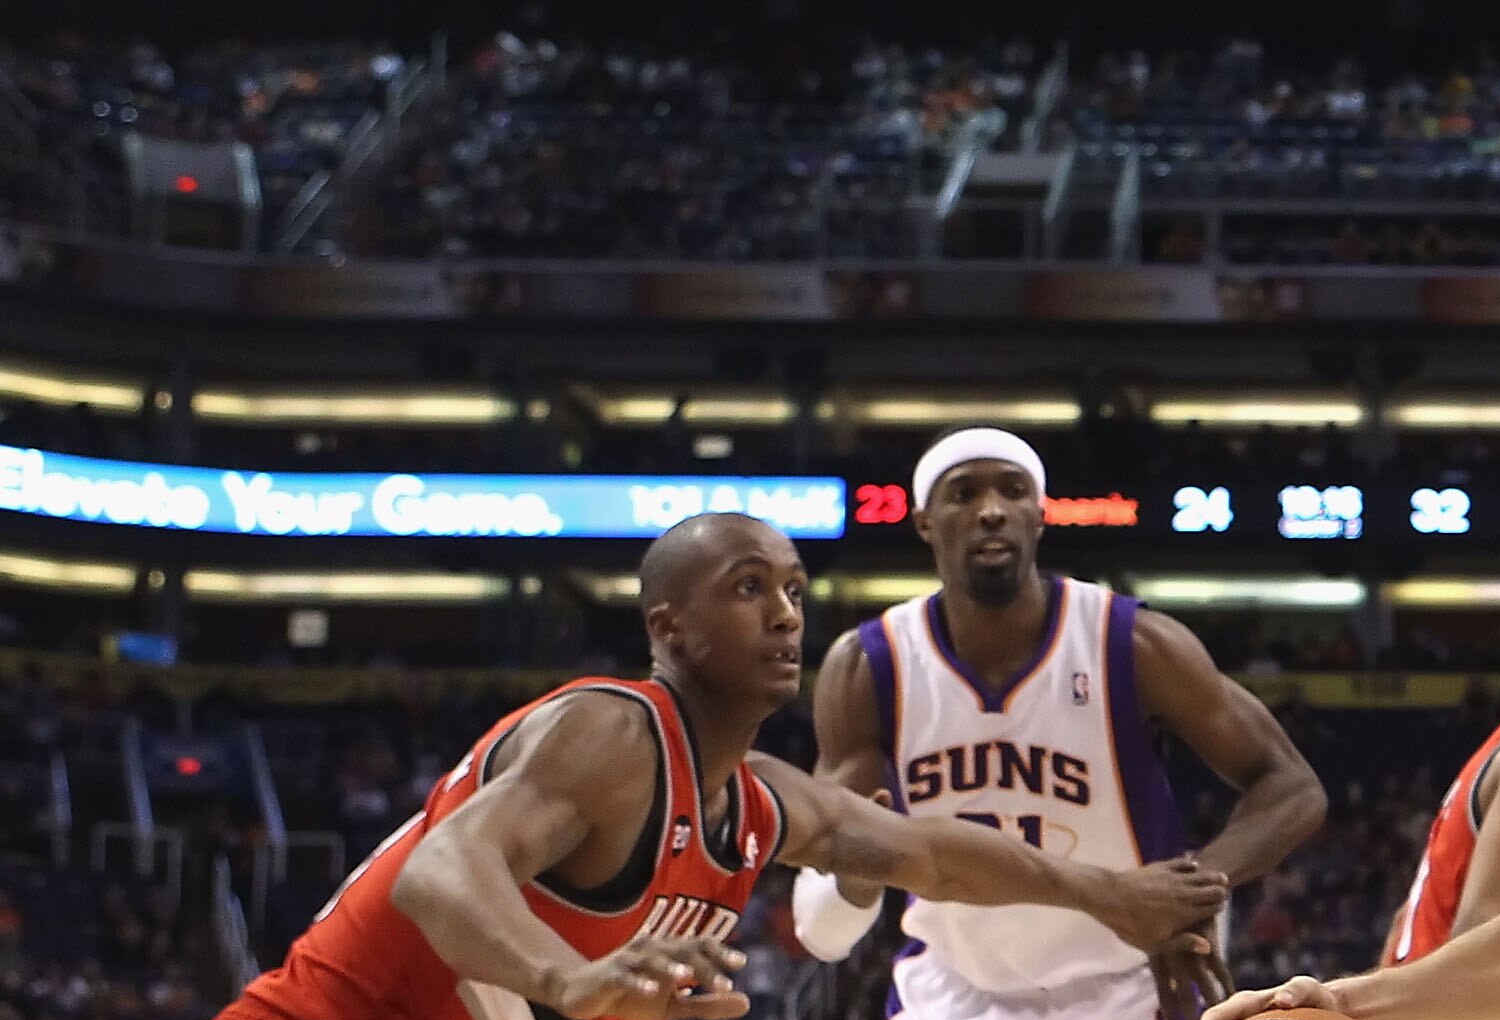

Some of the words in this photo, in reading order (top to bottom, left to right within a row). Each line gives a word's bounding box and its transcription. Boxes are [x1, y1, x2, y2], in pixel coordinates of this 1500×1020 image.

[221, 471, 364, 535] Your
[372, 473, 563, 536] Game.
[854, 484, 908, 524] 23
[1172, 486, 1234, 532] 24
[1410, 488, 1471, 533] 32
[906, 740, 1090, 806] SUNS
